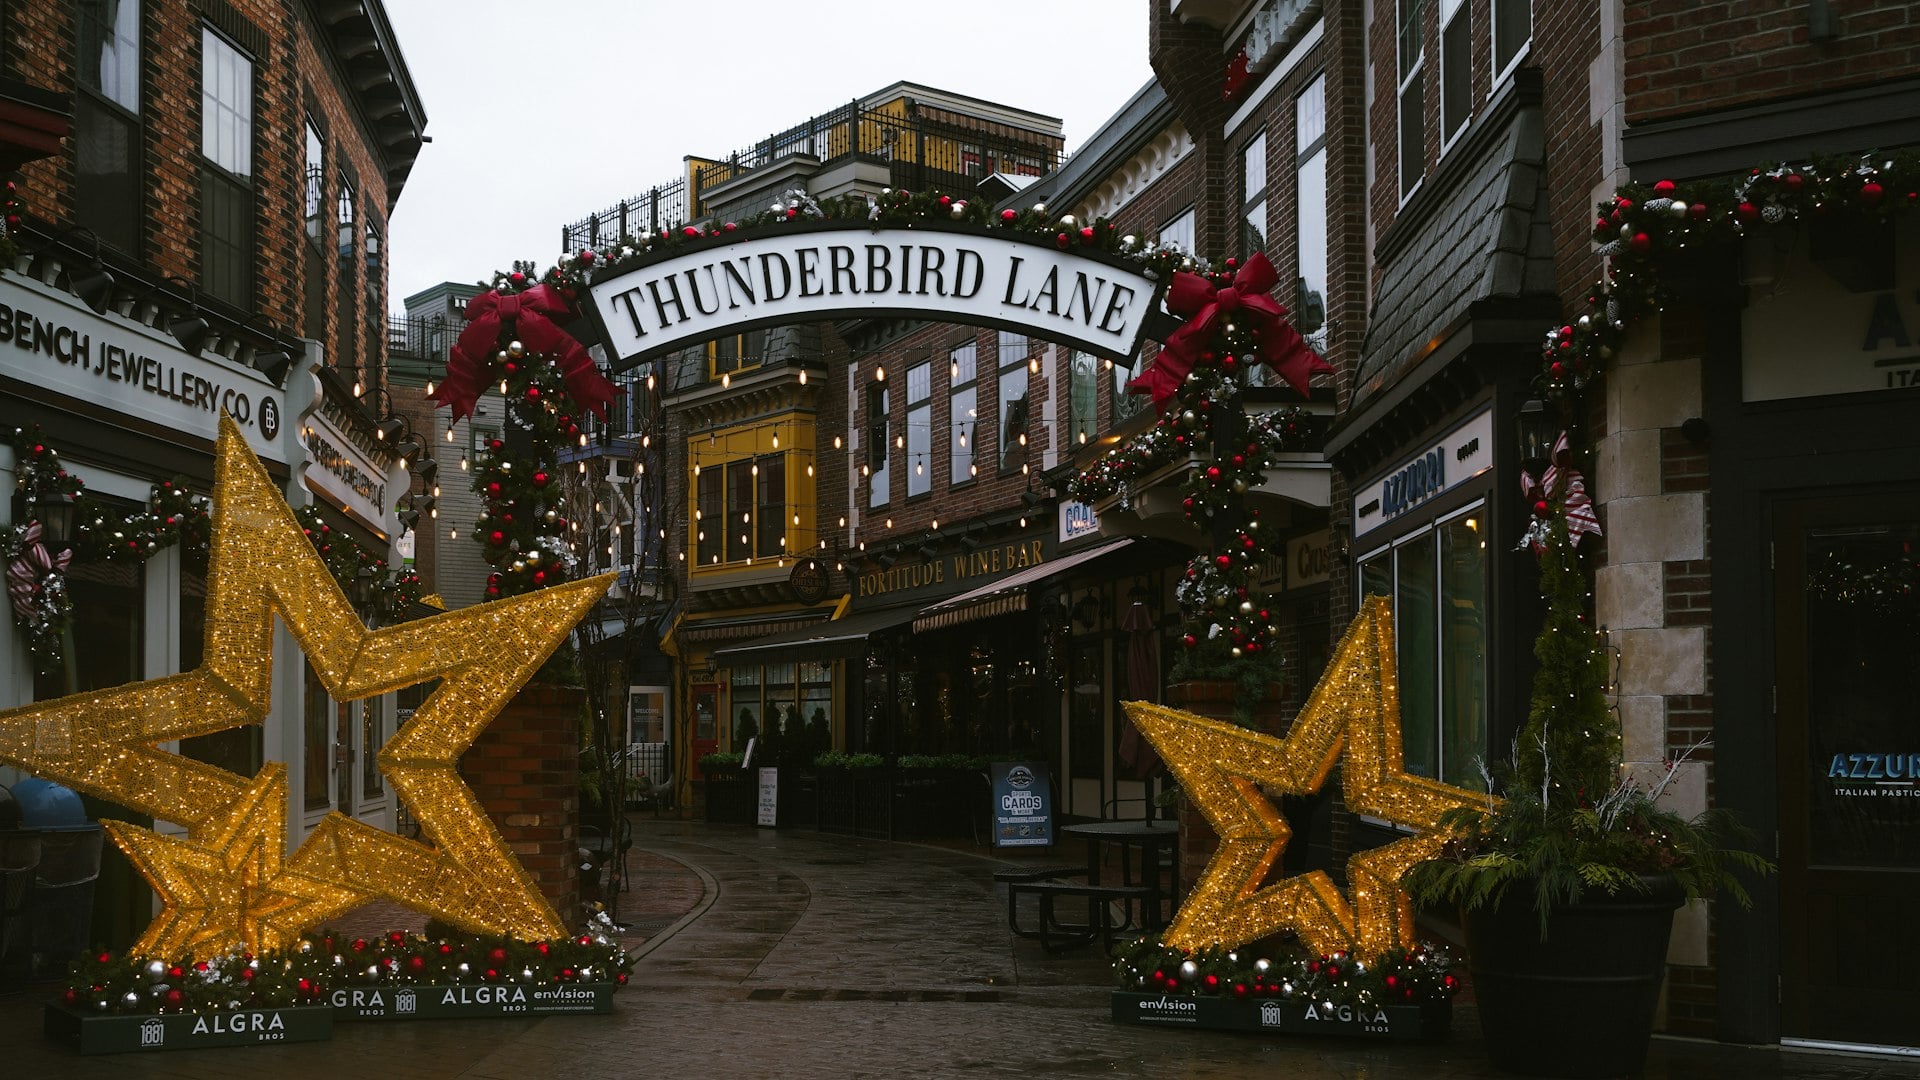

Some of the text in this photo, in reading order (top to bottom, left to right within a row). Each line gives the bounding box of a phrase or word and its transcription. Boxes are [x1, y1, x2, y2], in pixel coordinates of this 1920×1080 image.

[612, 245, 1135, 338] THUNDERBIRD LANE
[95, 342, 220, 413] JEWELLERY
[223, 388, 254, 426] CO.
[1382, 446, 1444, 517] AZZURRI
[859, 540, 1044, 597] FORTITUDE WINE BAR
[1828, 752, 1920, 778] AZZUR
[1003, 797, 1041, 809] CARDS
[440, 986, 528, 1004] ALGRA
[534, 985, 595, 999] envision
[1139, 996, 1196, 1011] envision
[192, 1012, 285, 1035] ALGRA
[259, 1032, 285, 1041] BROS
